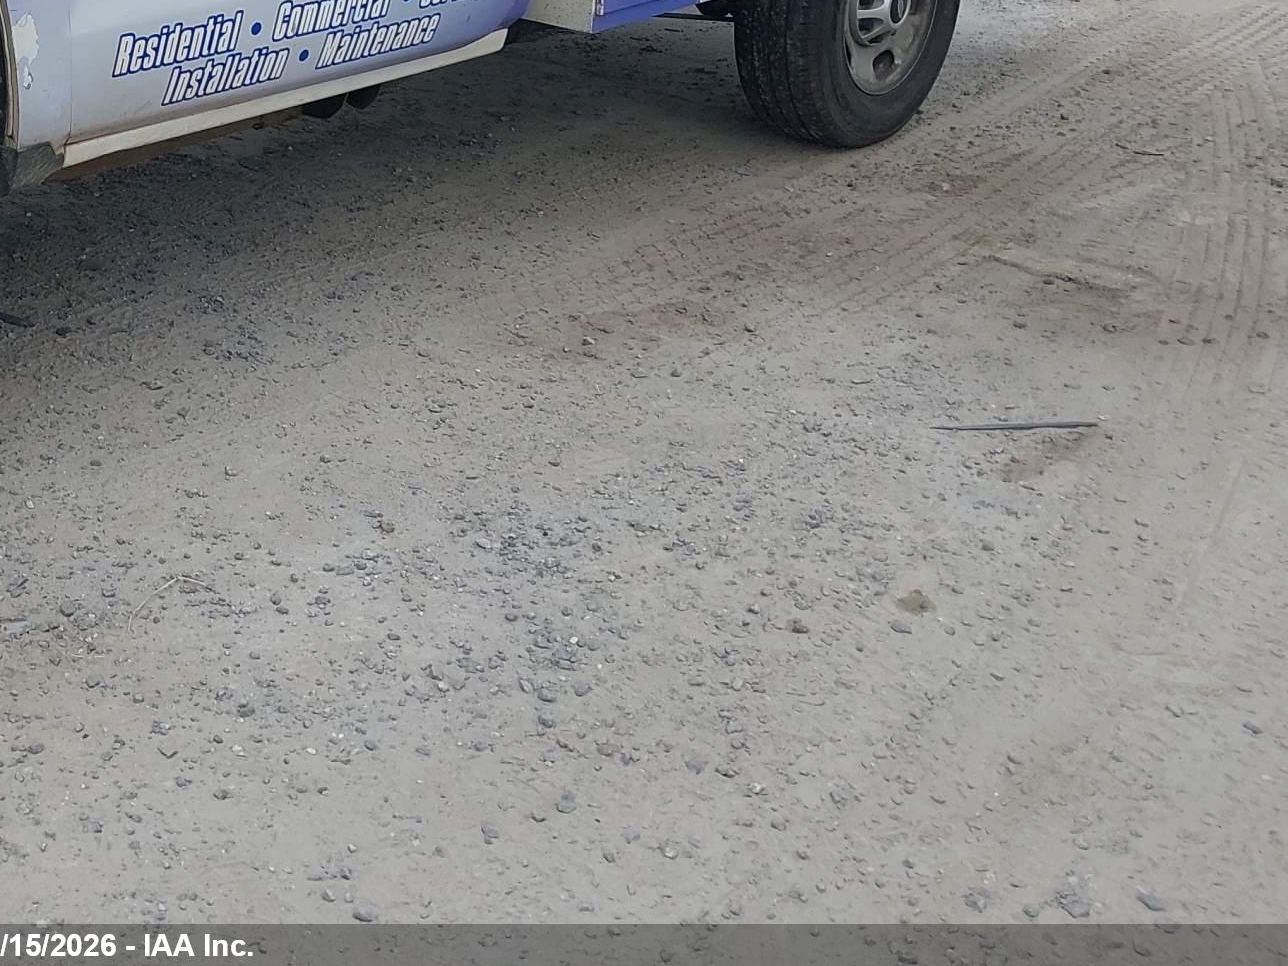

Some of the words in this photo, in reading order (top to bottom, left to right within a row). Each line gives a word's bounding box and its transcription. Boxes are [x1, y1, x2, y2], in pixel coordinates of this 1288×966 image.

[112, 10, 244, 78] Residential
[161, 47, 290, 106] Installation
[315, 13, 441, 70] Maintenance
